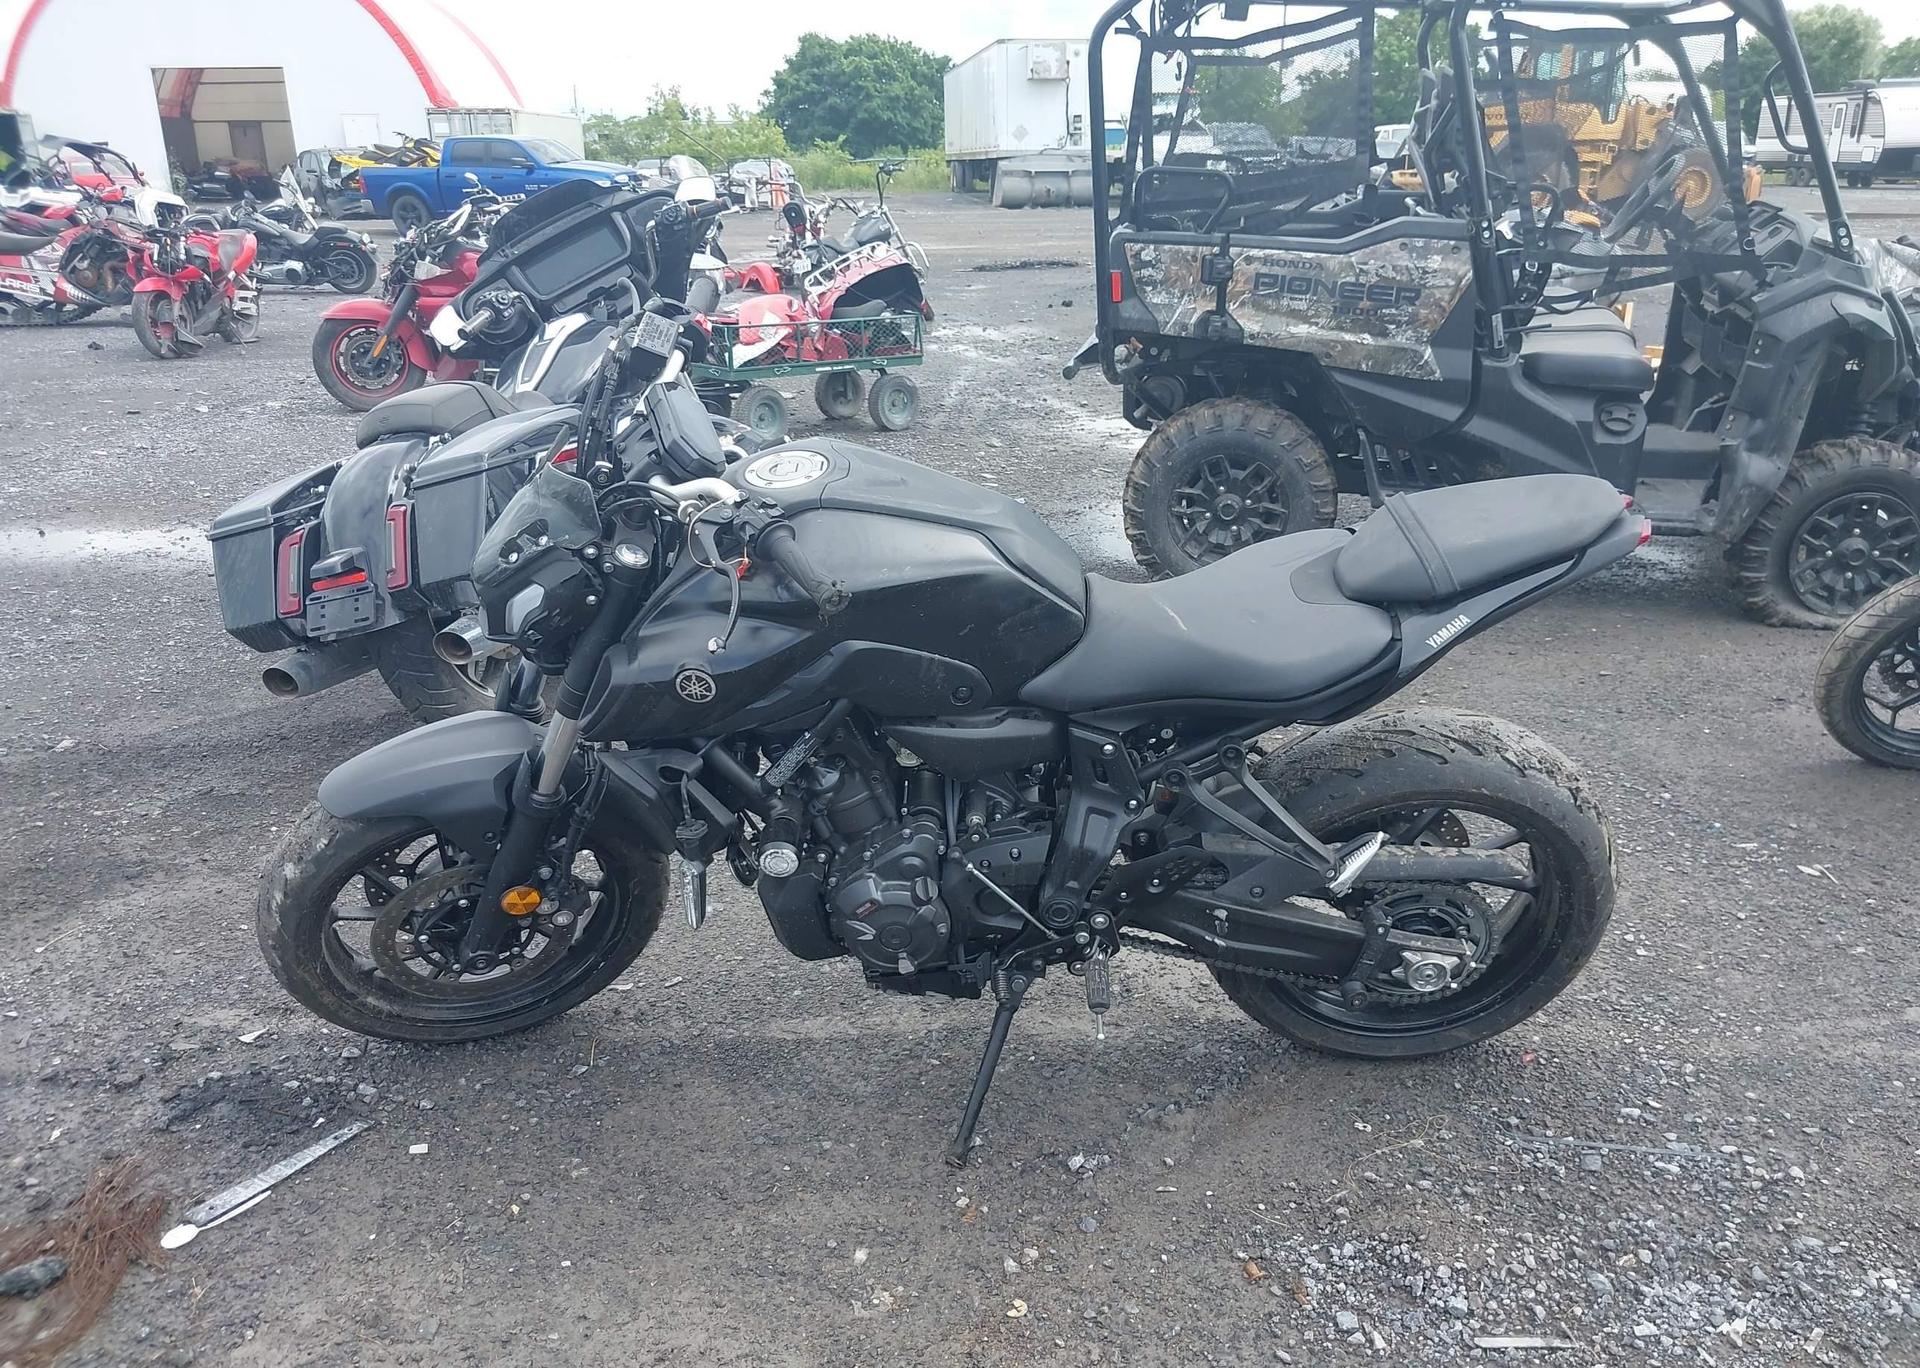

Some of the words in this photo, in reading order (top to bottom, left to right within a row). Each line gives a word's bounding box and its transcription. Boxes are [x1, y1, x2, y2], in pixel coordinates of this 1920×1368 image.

[1263, 258, 1324, 271] HONDA
[1253, 272, 1422, 305] PIONEER
[1425, 614, 1471, 648] YAMAHA
